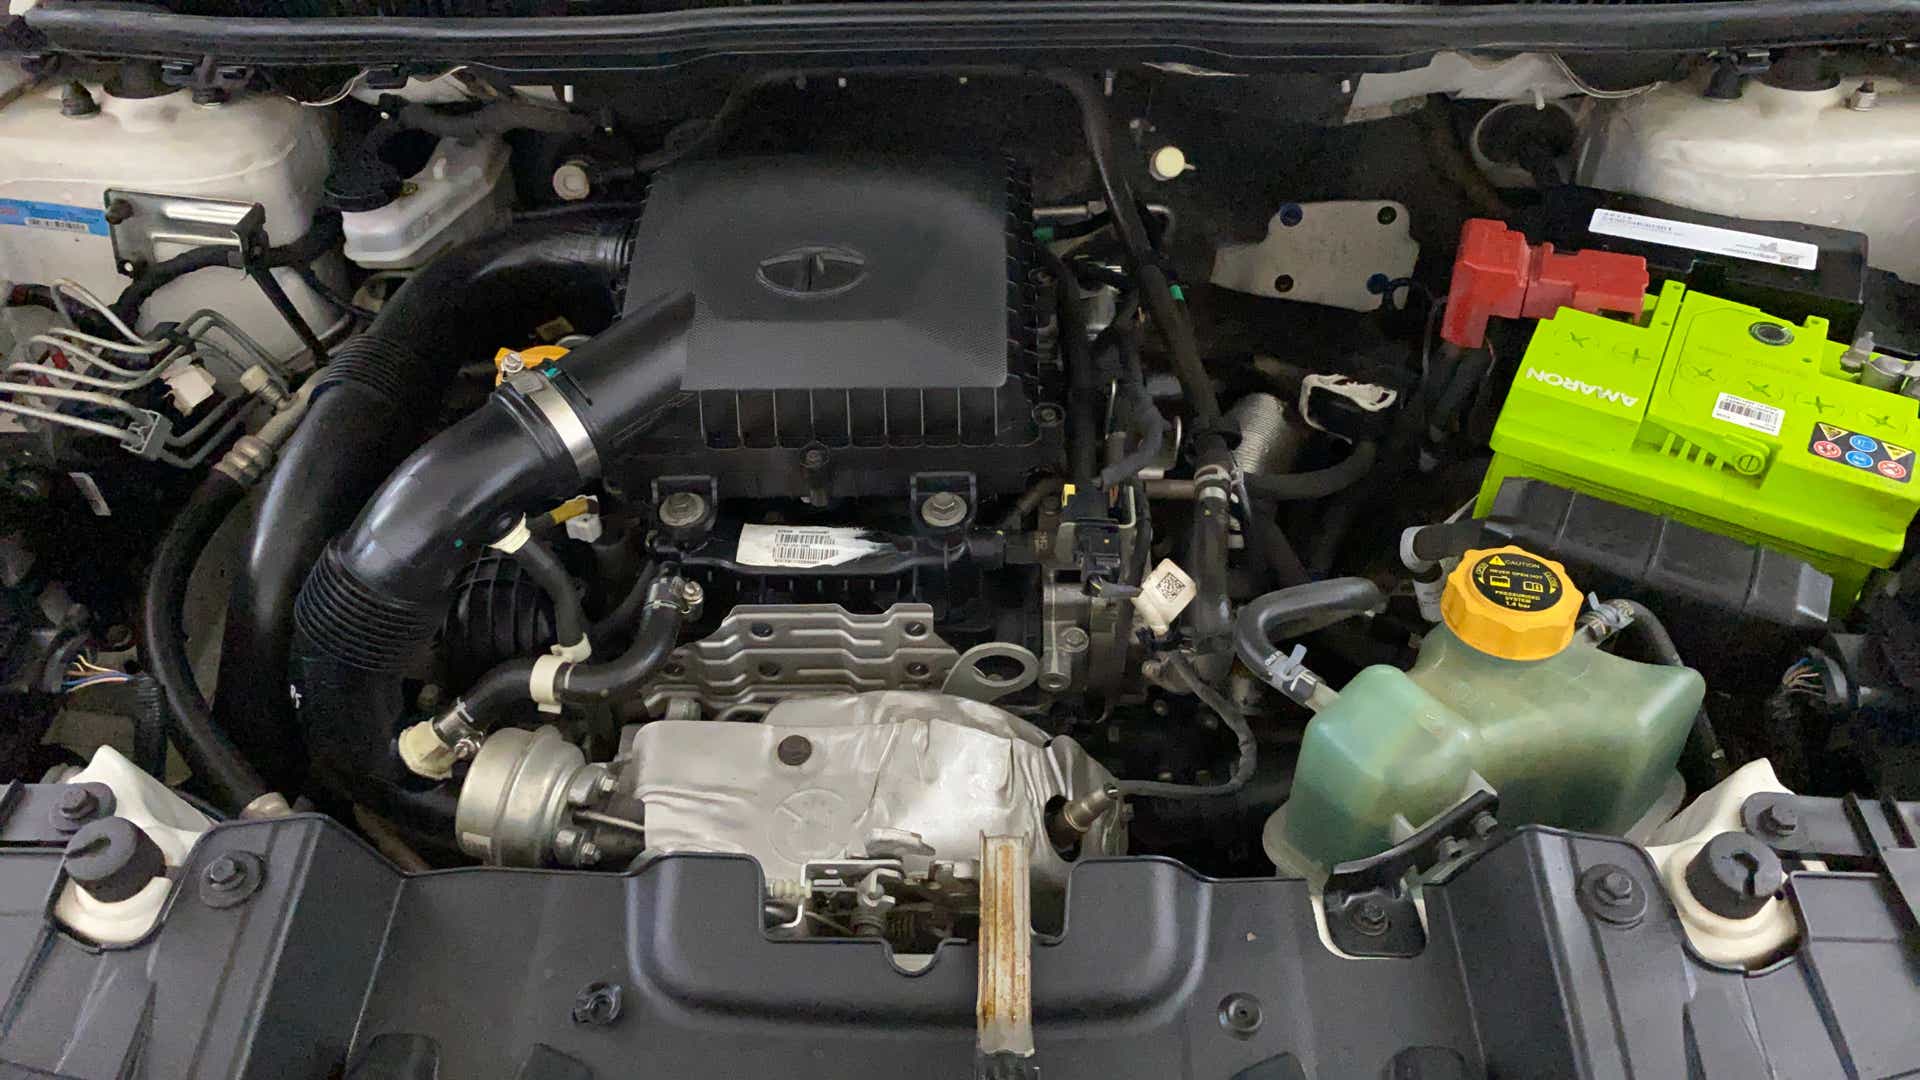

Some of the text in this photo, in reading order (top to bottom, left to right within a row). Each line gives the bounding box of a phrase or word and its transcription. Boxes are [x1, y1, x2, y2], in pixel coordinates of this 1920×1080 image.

[1526, 367, 1639, 407] AMARON
[1504, 559, 1540, 569] CAUTION
[1505, 595, 1532, 604] SYSTEM
